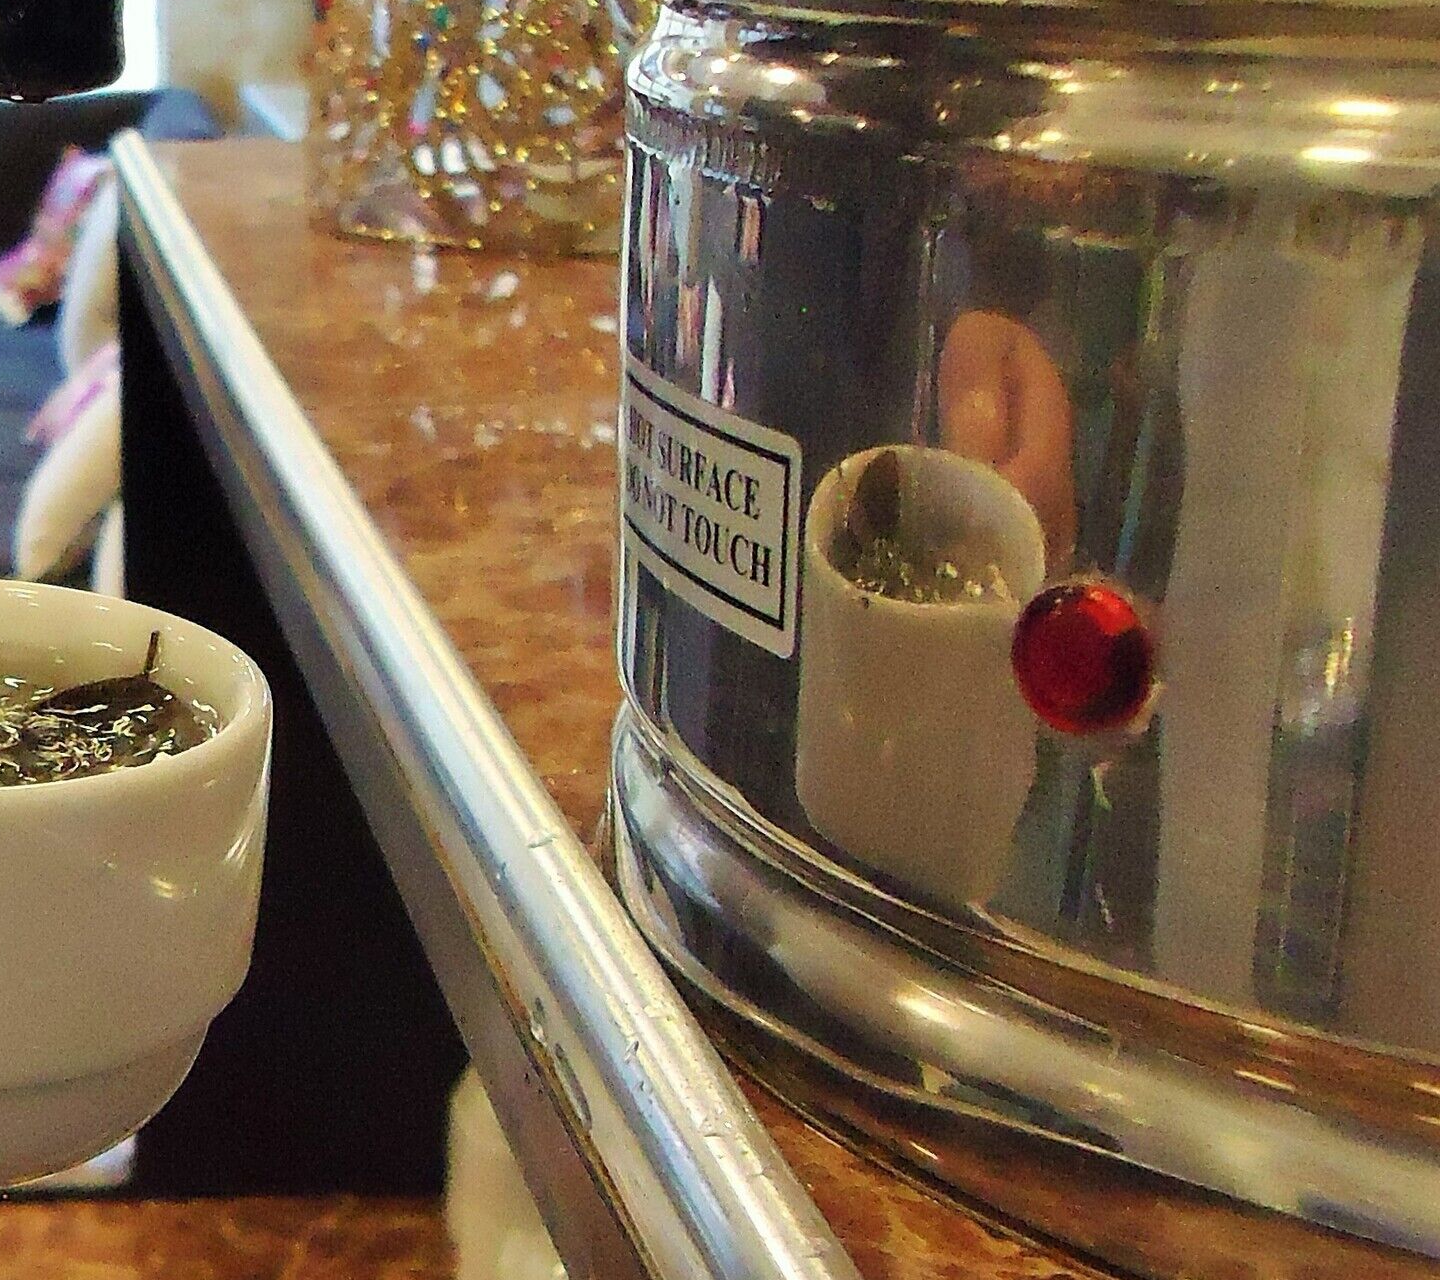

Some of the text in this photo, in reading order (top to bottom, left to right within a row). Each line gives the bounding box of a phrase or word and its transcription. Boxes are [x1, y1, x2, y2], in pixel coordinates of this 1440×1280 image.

[658, 429, 761, 520] SURFACE
[643, 474, 678, 533] NOT
[681, 503, 772, 588] TOUCH
